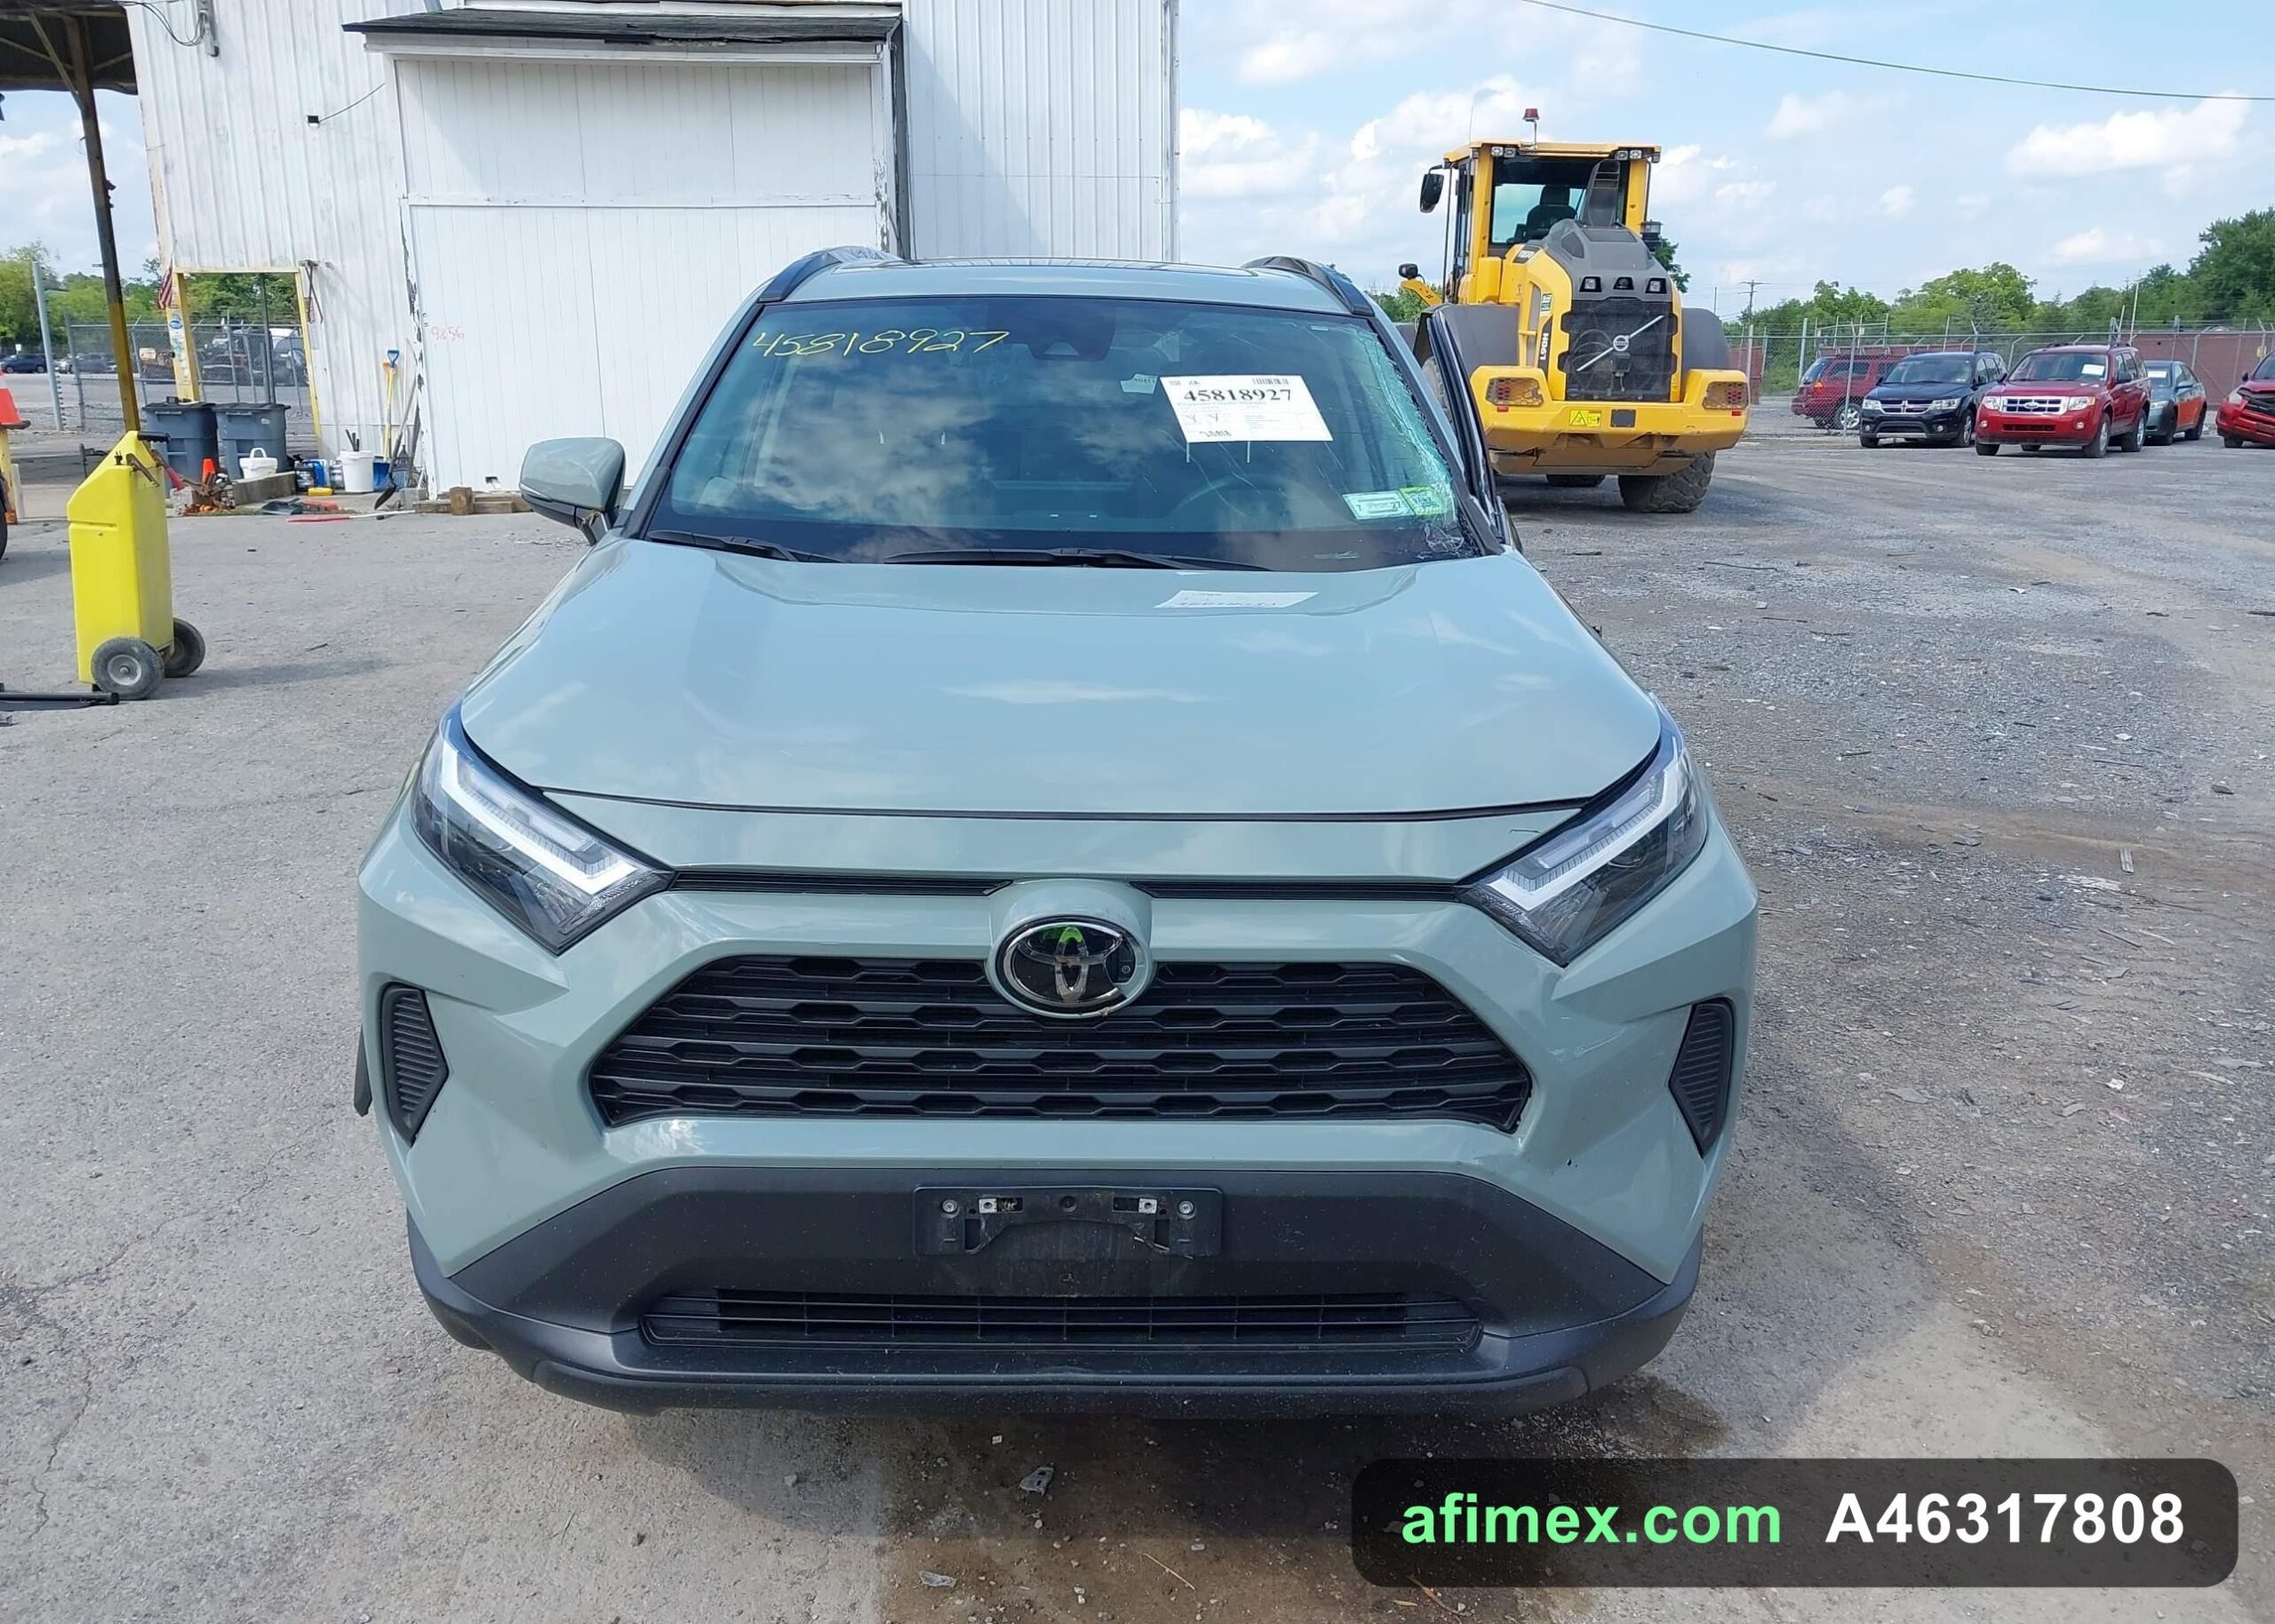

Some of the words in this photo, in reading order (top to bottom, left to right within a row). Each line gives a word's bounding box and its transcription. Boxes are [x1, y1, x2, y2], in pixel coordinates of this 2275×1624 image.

[753, 328, 1010, 356] 45818927
[1539, 333, 1549, 361] L90H
[1183, 388, 1292, 402] 45818927
